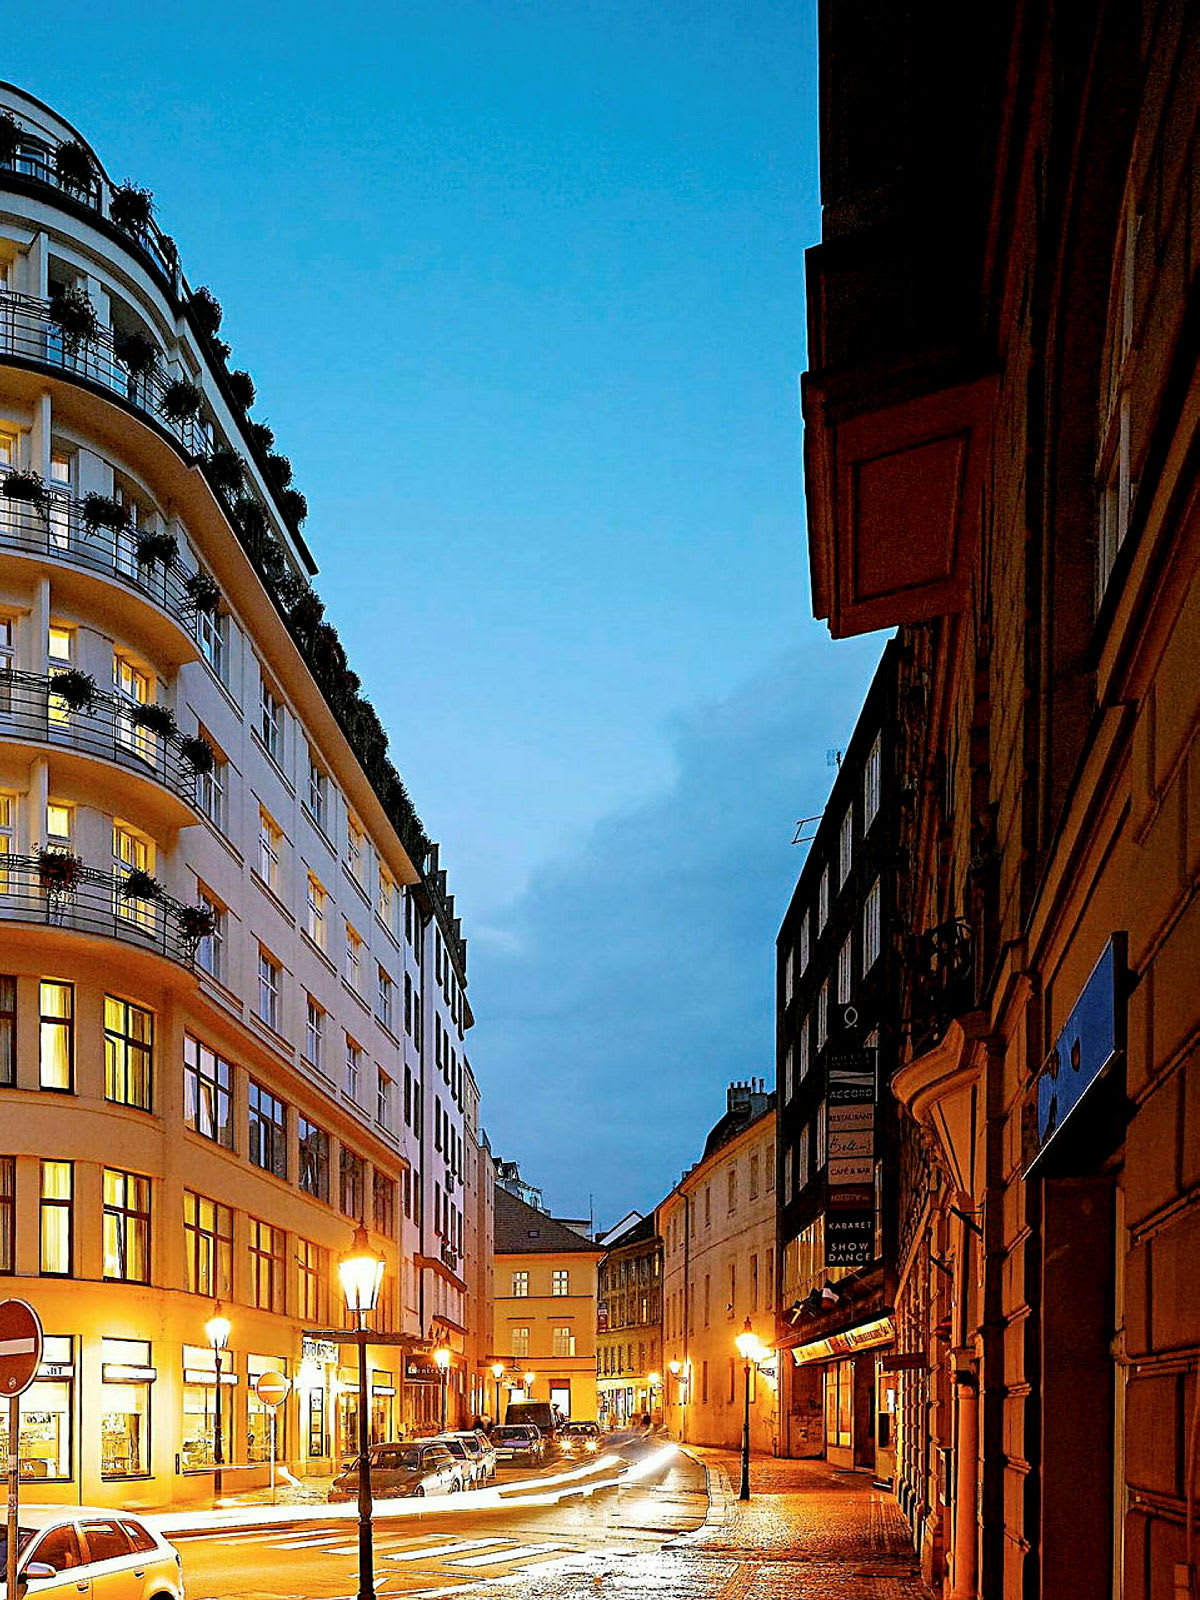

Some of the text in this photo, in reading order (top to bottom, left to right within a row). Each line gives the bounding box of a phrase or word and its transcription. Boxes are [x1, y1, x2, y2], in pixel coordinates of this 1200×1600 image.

[829, 1088, 873, 1099] ACCORD
[828, 1221, 872, 1230] KABARET
[831, 1242, 869, 1252] SHOW
[828, 1252, 871, 1262] DANCE
